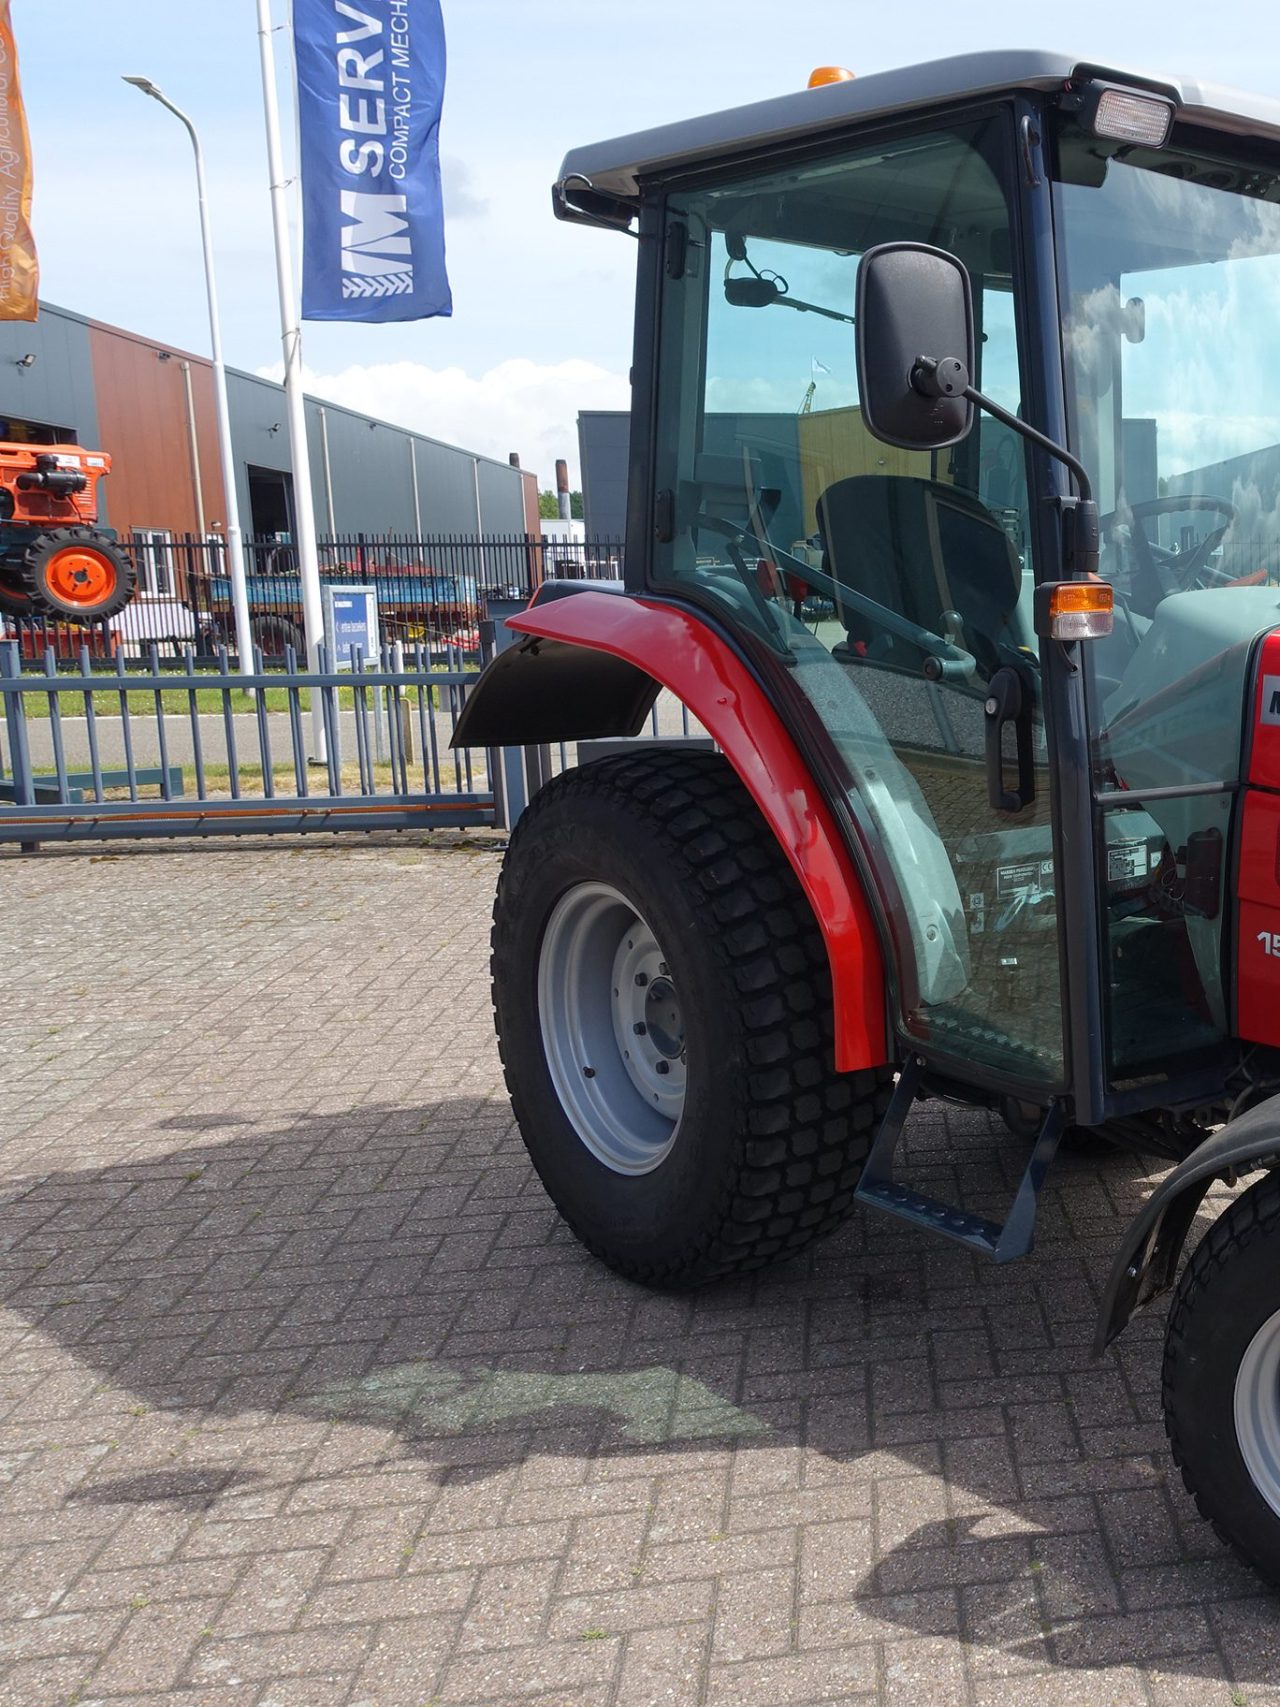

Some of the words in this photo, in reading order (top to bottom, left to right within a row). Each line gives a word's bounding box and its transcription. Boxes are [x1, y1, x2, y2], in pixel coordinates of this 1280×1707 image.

[390, 0, 411, 68] MECH
[389, 72, 411, 179] COMPACT
[0, 184, 23, 250] Quality
